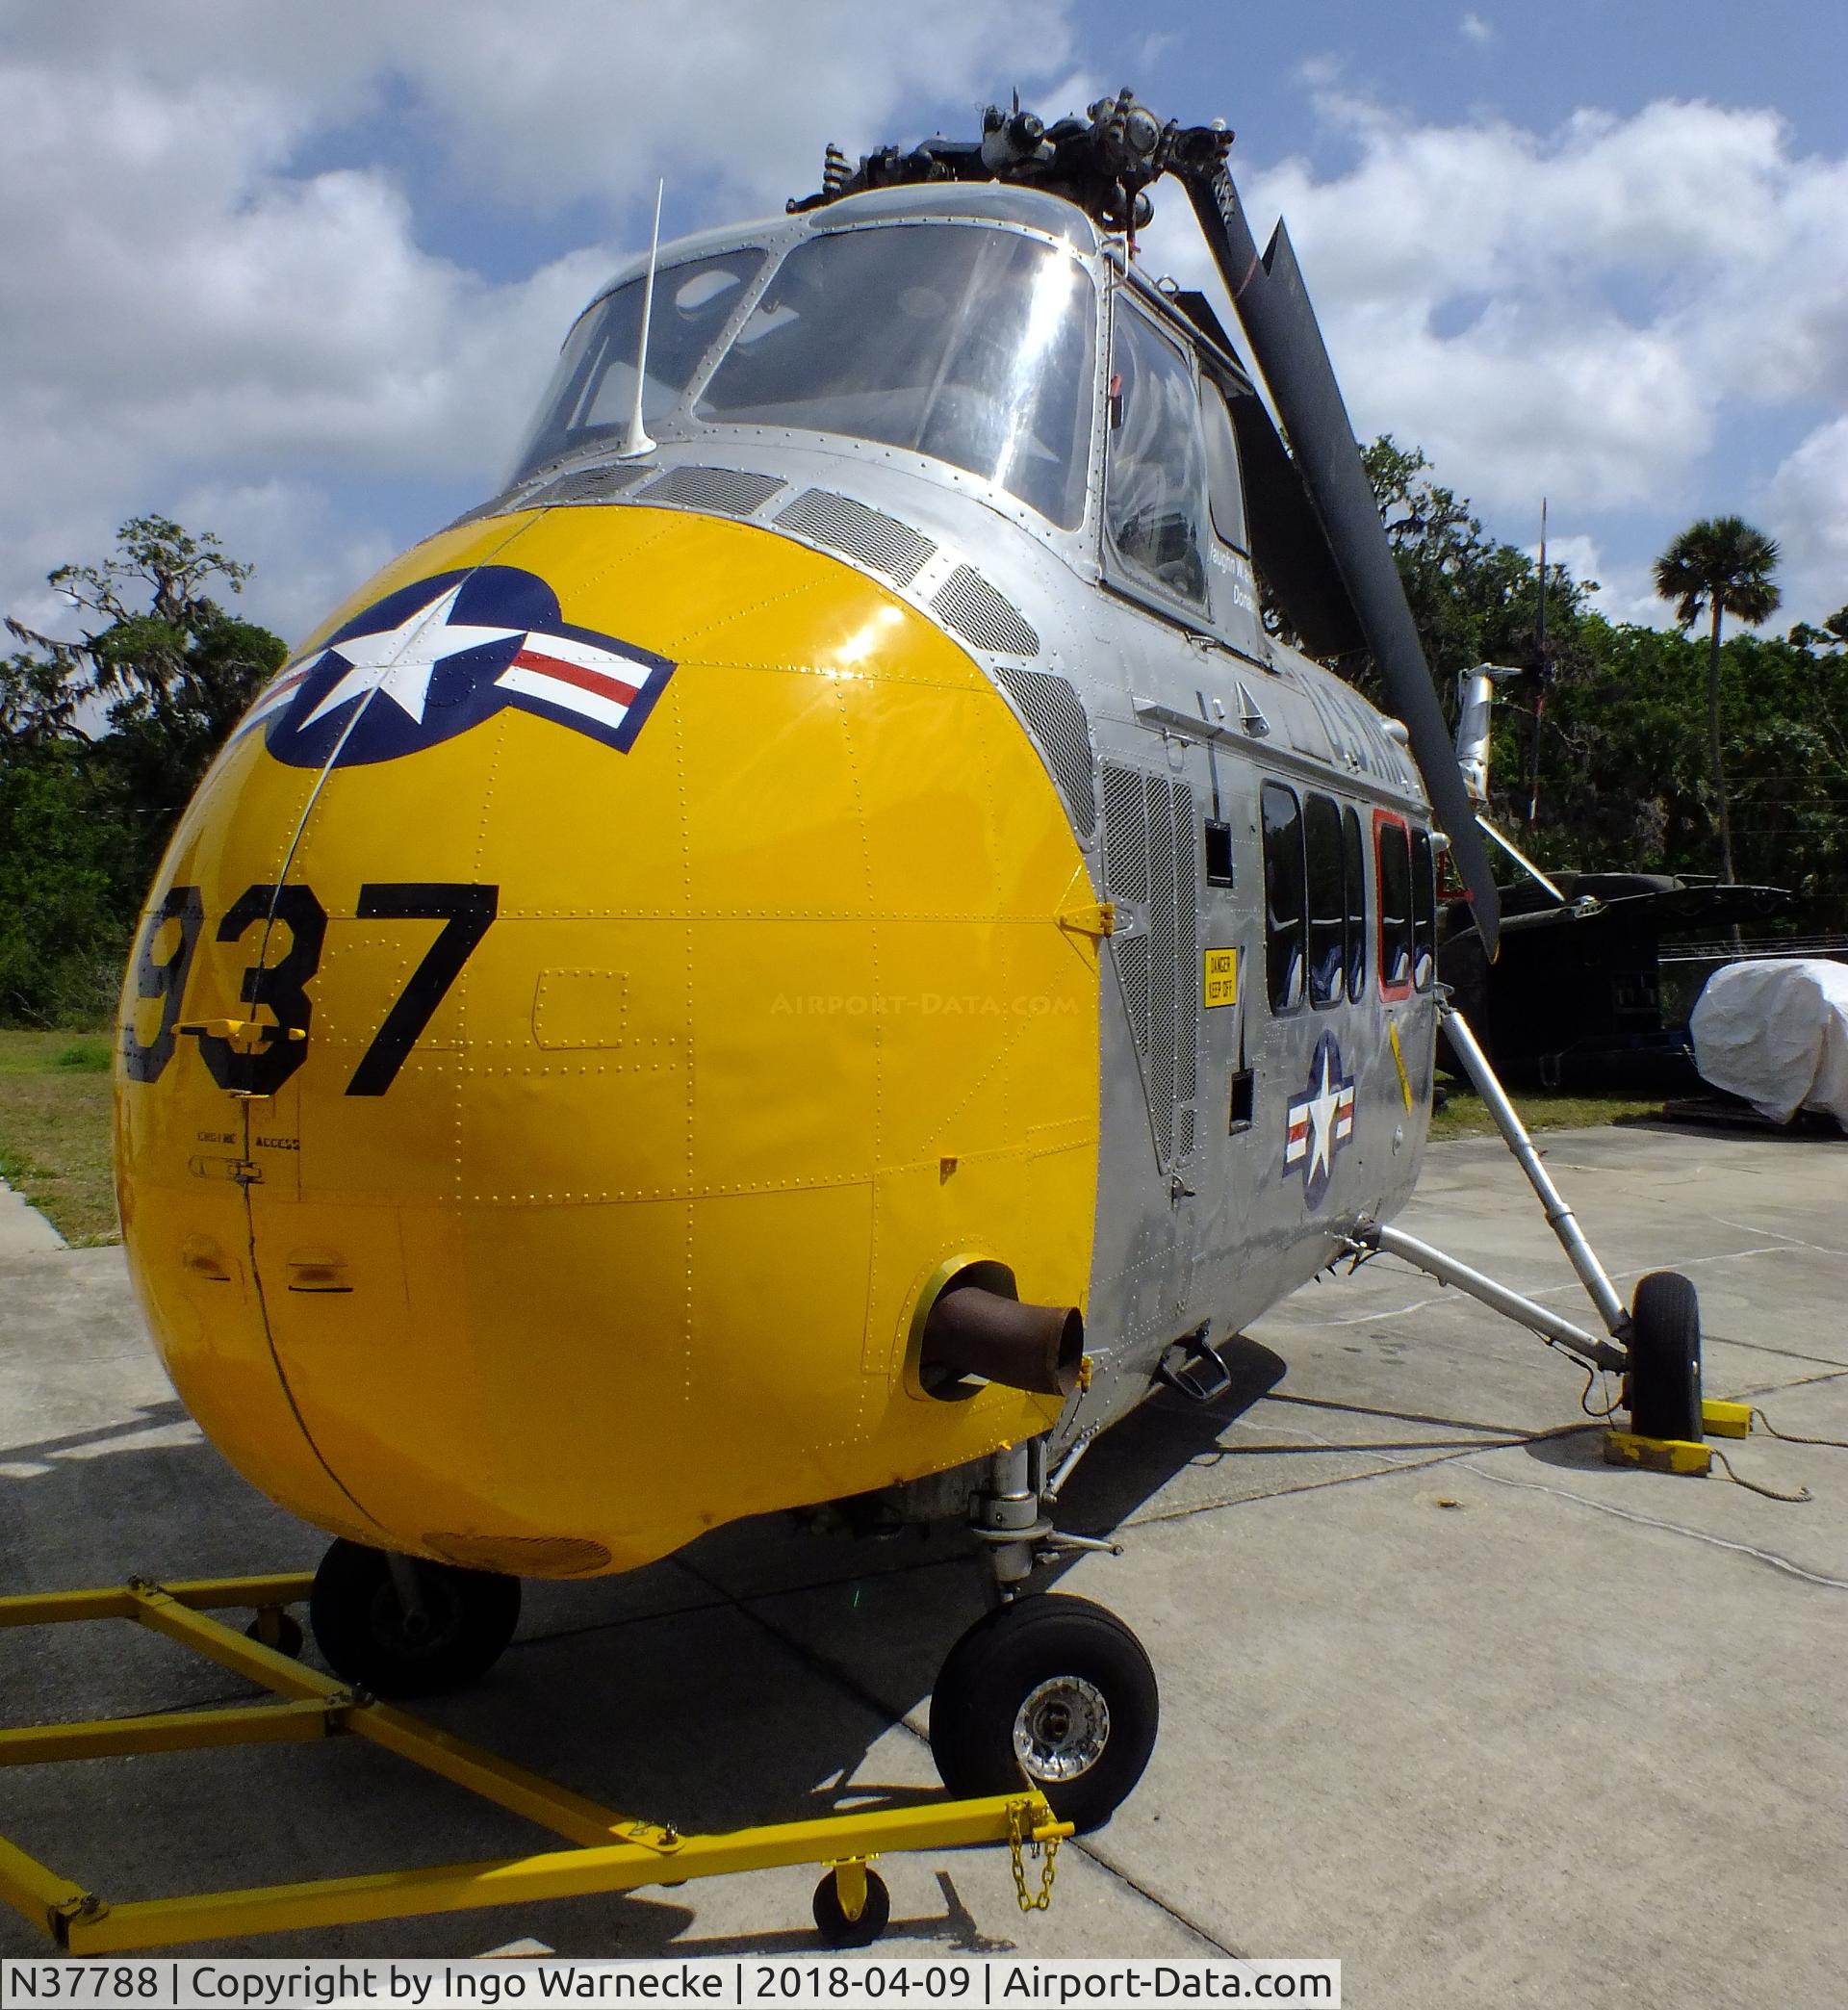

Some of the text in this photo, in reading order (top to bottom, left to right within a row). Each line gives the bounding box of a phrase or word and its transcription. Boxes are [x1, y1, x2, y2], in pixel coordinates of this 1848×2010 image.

[1210, 956, 1231, 973] DANGER
[122, 884, 500, 1095] 937
[1209, 979, 1232, 998] KEEP OFF
[256, 1137, 300, 1150] ACCESS
